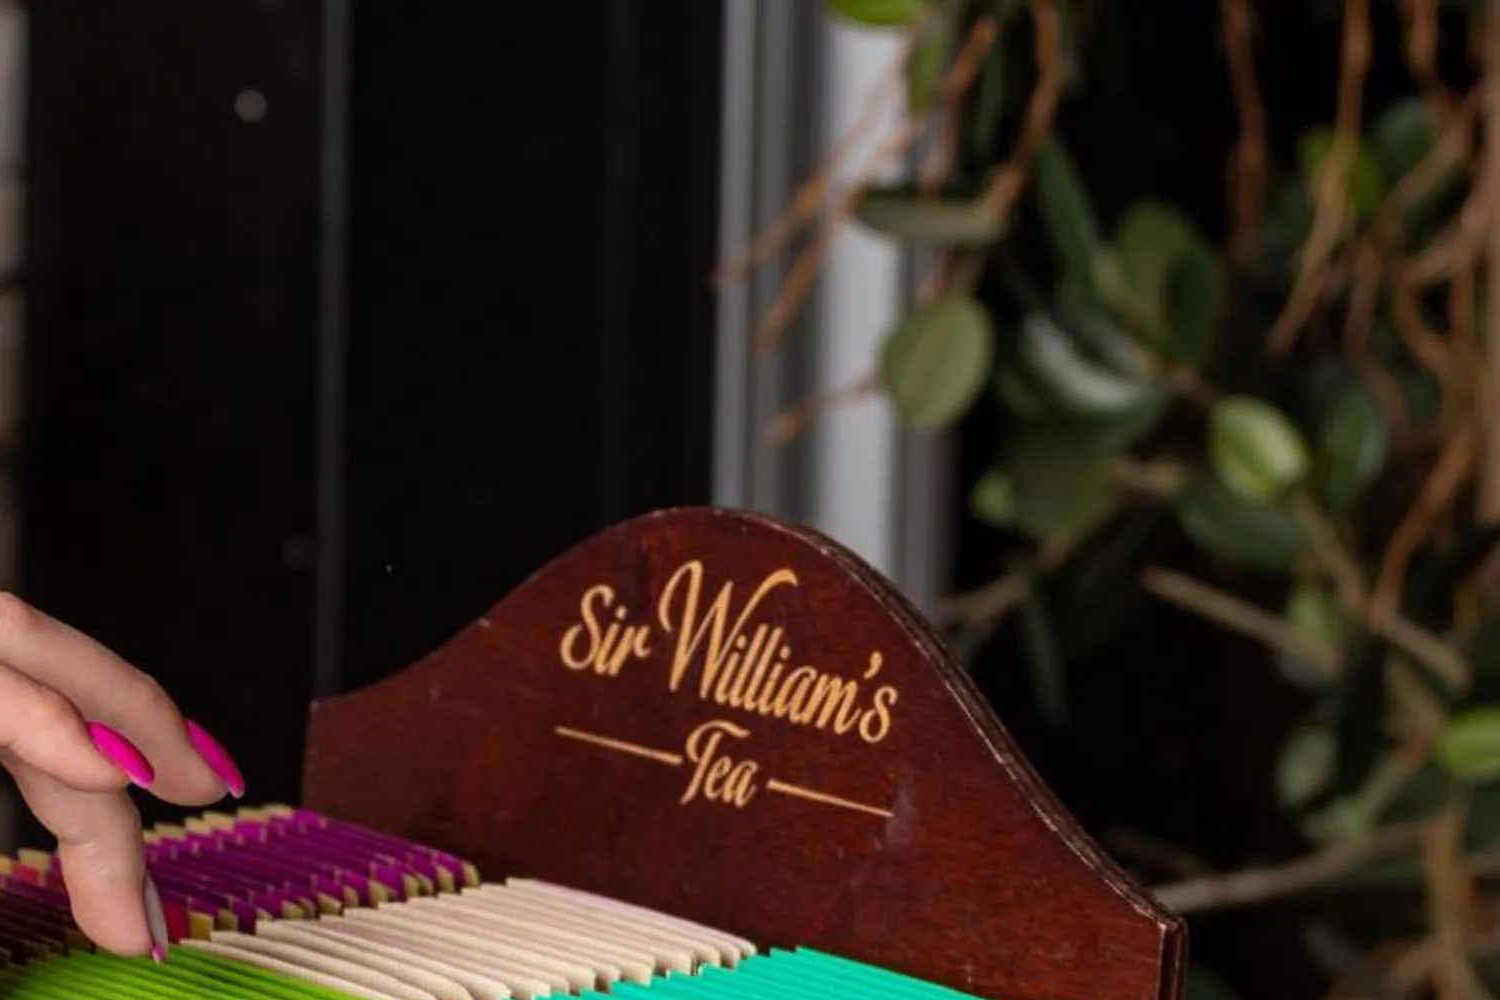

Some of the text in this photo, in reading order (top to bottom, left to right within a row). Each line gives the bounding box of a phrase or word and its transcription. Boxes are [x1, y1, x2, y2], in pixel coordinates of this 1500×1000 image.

[560, 560, 898, 743] Sir William's
[684, 720, 759, 807] Tea
